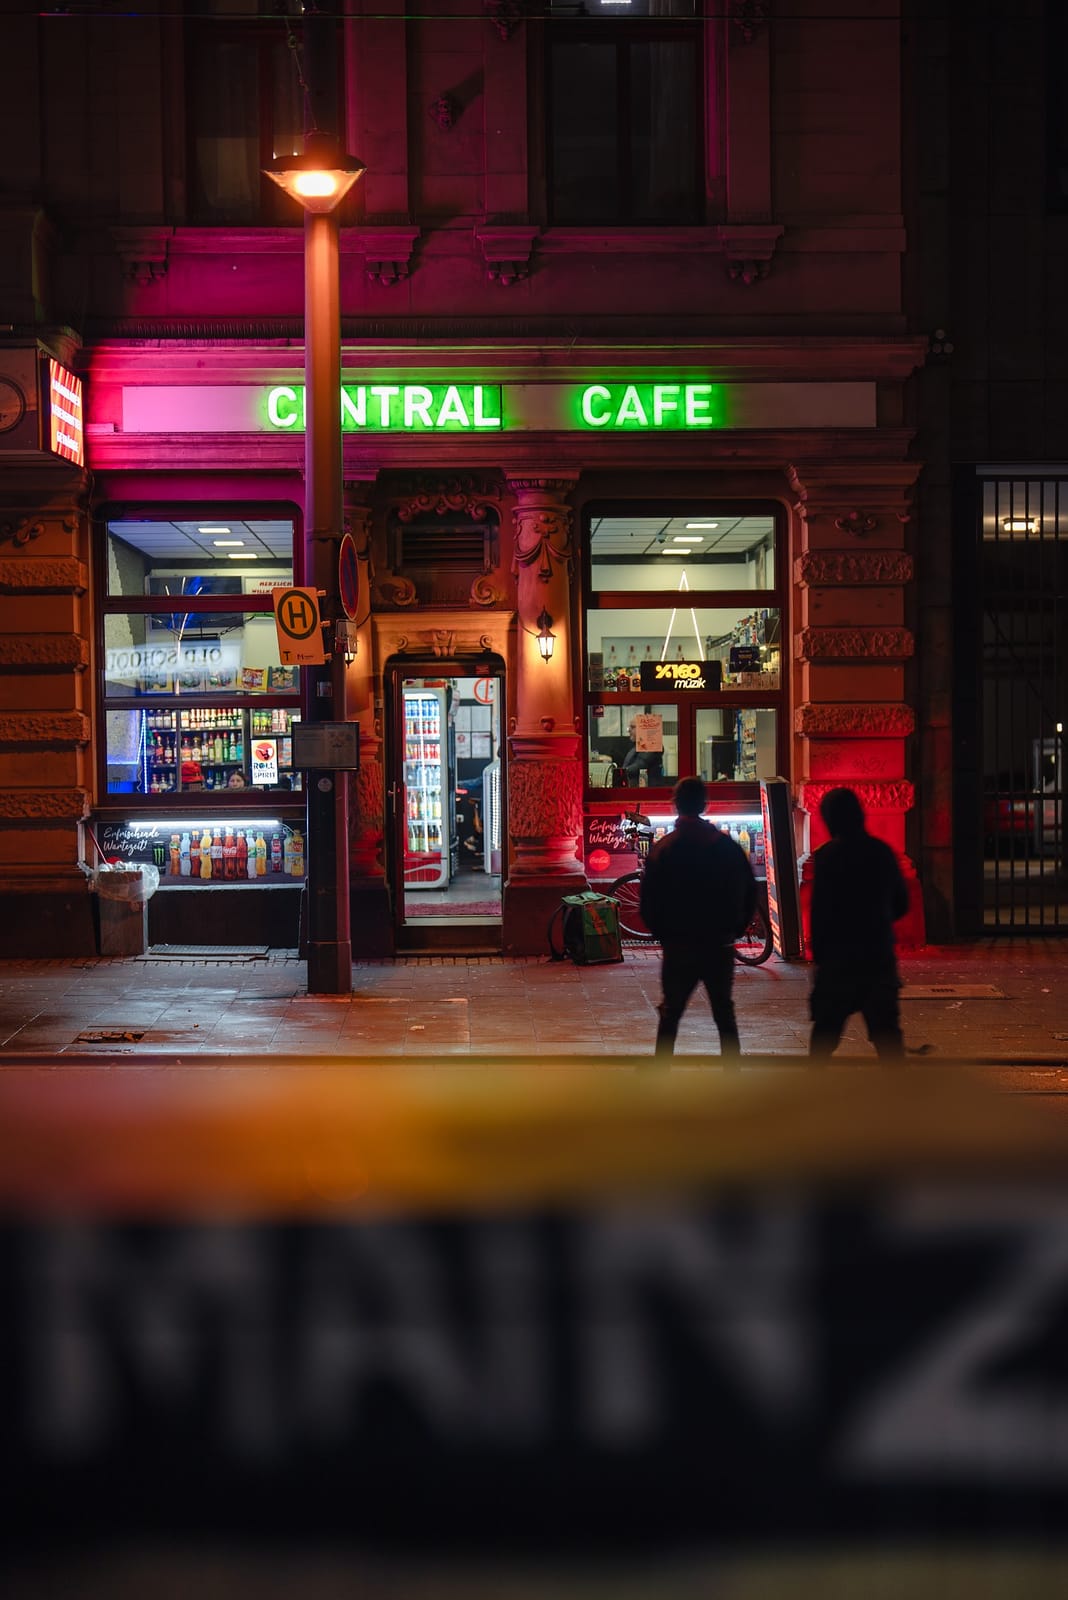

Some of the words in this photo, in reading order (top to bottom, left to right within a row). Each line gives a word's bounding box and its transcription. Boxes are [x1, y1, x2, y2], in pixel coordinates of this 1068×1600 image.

[267, 385, 501, 428] CNTRAL
[582, 385, 713, 426] CAFE
[288, 601, 307, 629] H
[103, 825, 160, 840] Erfrischende
